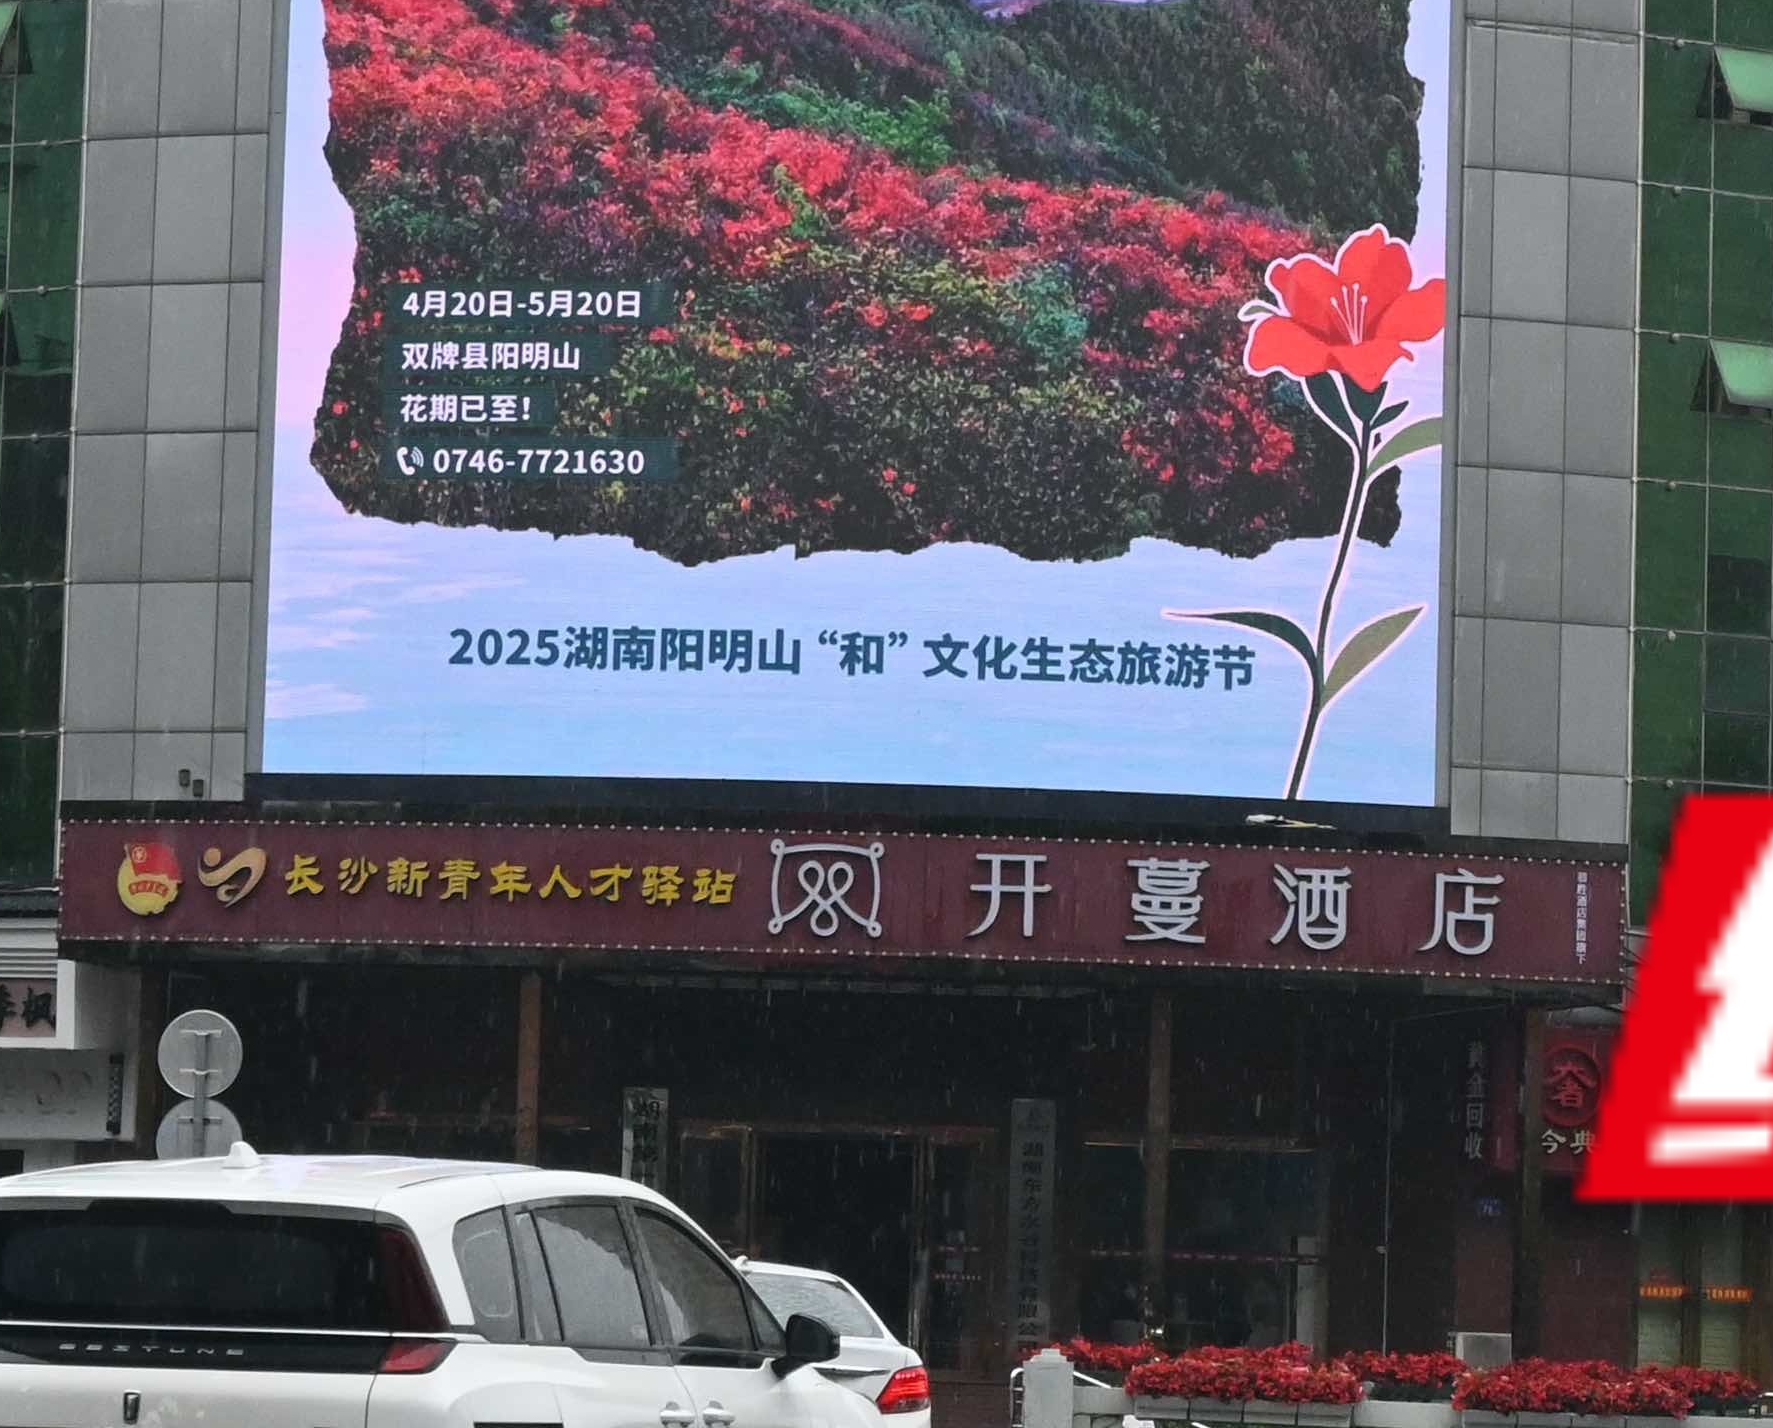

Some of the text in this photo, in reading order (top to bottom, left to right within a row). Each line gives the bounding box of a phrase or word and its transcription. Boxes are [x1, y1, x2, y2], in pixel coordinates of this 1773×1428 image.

[401, 289, 643, 319] 4月20日-5月20日
[401, 341, 581, 371] 双牌县阳明山
[432, 448, 646, 476] 0746-7721630
[283, 854, 740, 909] 长沙新青年人才驿站
[966, 851, 1506, 957] 开蔓酒店
[1464, 1040, 1486, 1160] 黄金回收
